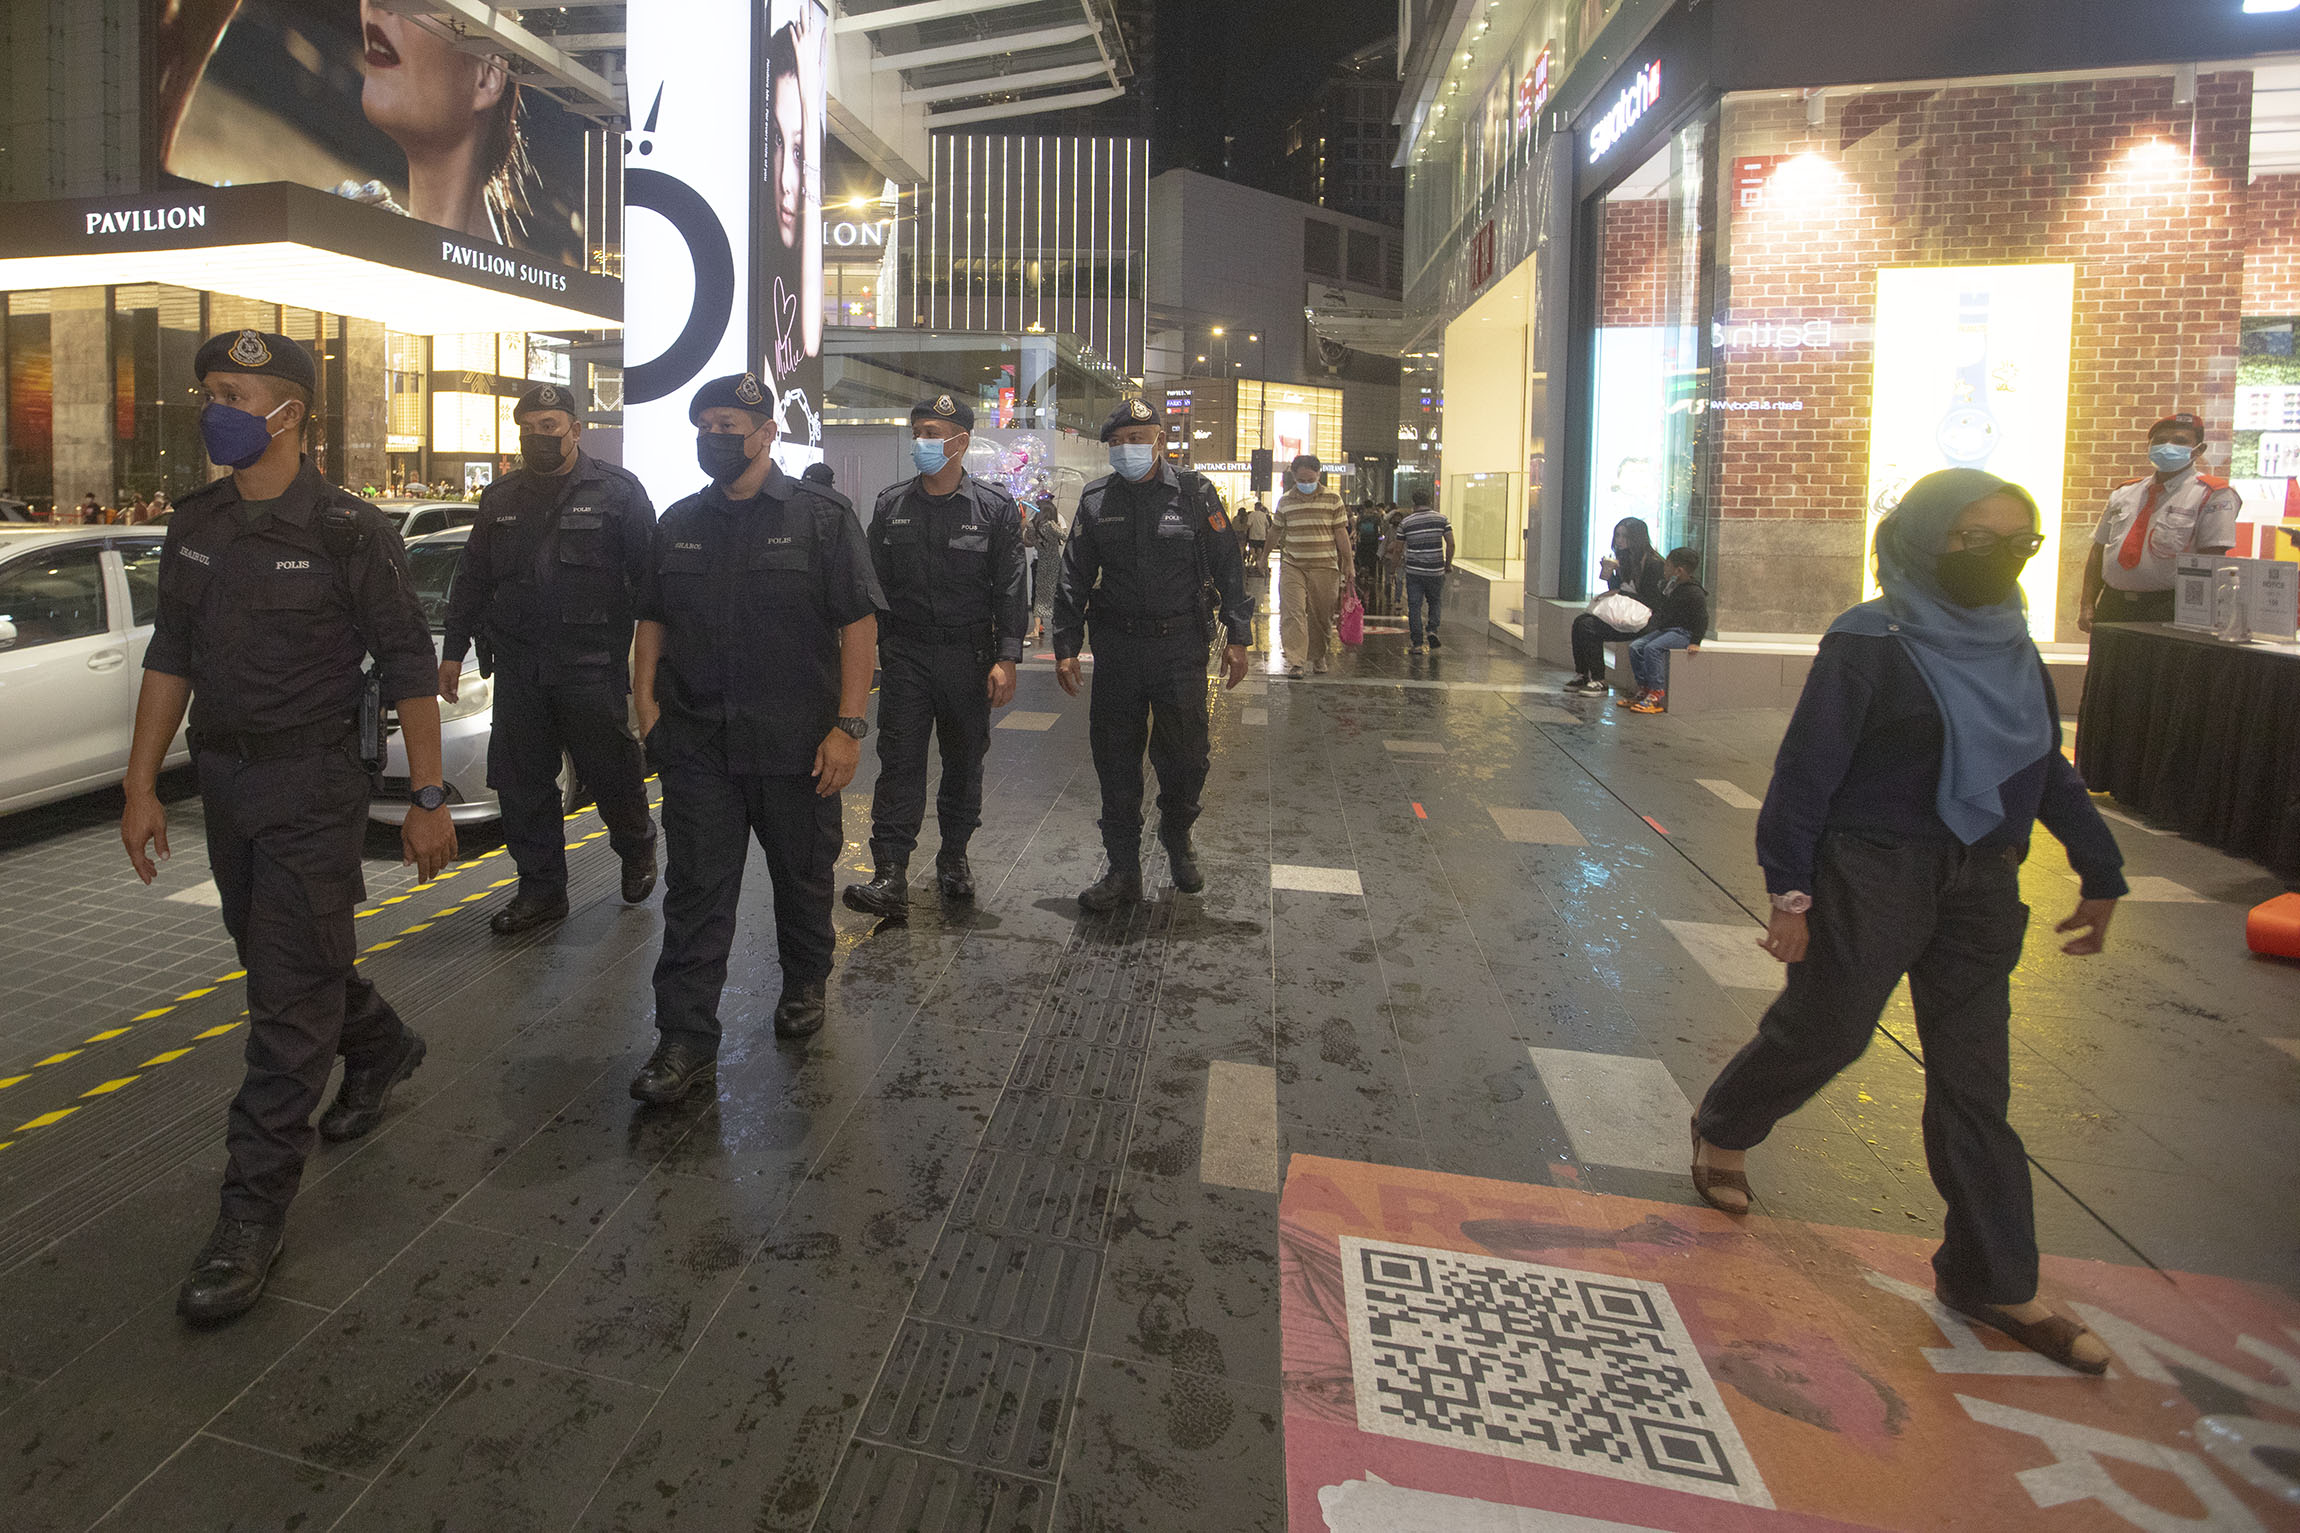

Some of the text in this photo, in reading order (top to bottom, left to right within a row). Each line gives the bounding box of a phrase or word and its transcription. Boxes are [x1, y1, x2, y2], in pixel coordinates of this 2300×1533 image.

[1590, 63, 1649, 164] swatch
[86, 205, 206, 234] PAVILION
[823, 221, 882, 246] ION
[442, 241, 567, 291] PAVILION SUITES
[1194, 463, 1226, 471] BINTANG
[275, 560, 310, 570] POLIS
